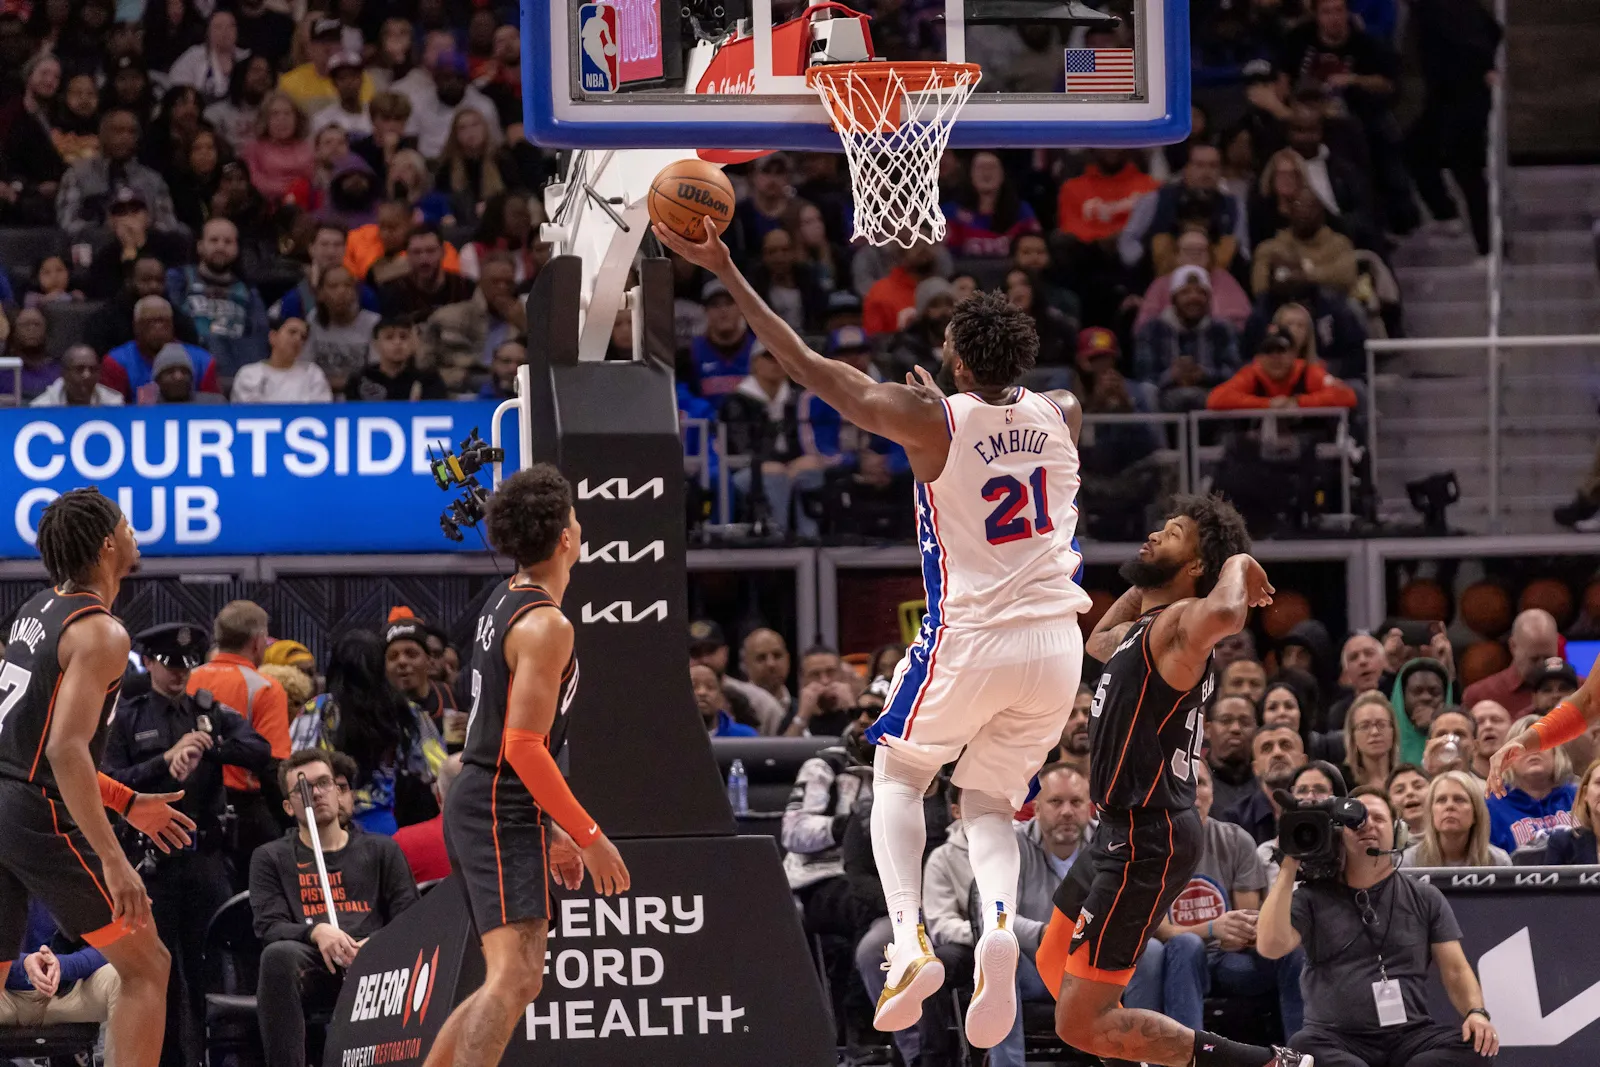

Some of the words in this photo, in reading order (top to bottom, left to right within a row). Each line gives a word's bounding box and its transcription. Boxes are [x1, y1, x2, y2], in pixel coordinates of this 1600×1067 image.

[585, 73, 605, 88] NBA
[677, 182, 729, 216] Wilson
[13, 416, 454, 482] COURTSIDE
[974, 429, 1049, 465] EMBIID
[577, 477, 664, 499] KIA
[981, 466, 1055, 545] 21
[15, 485, 222, 545] CUB
[581, 600, 668, 623] KIA
[0, 658, 32, 734] 7
[299, 871, 342, 887] DETOIT
[301, 887, 346, 902] PISTNS
[547, 894, 705, 938] ENRY
[350, 967, 410, 1022] BELFOR
[525, 995, 746, 1041] HEALTH
